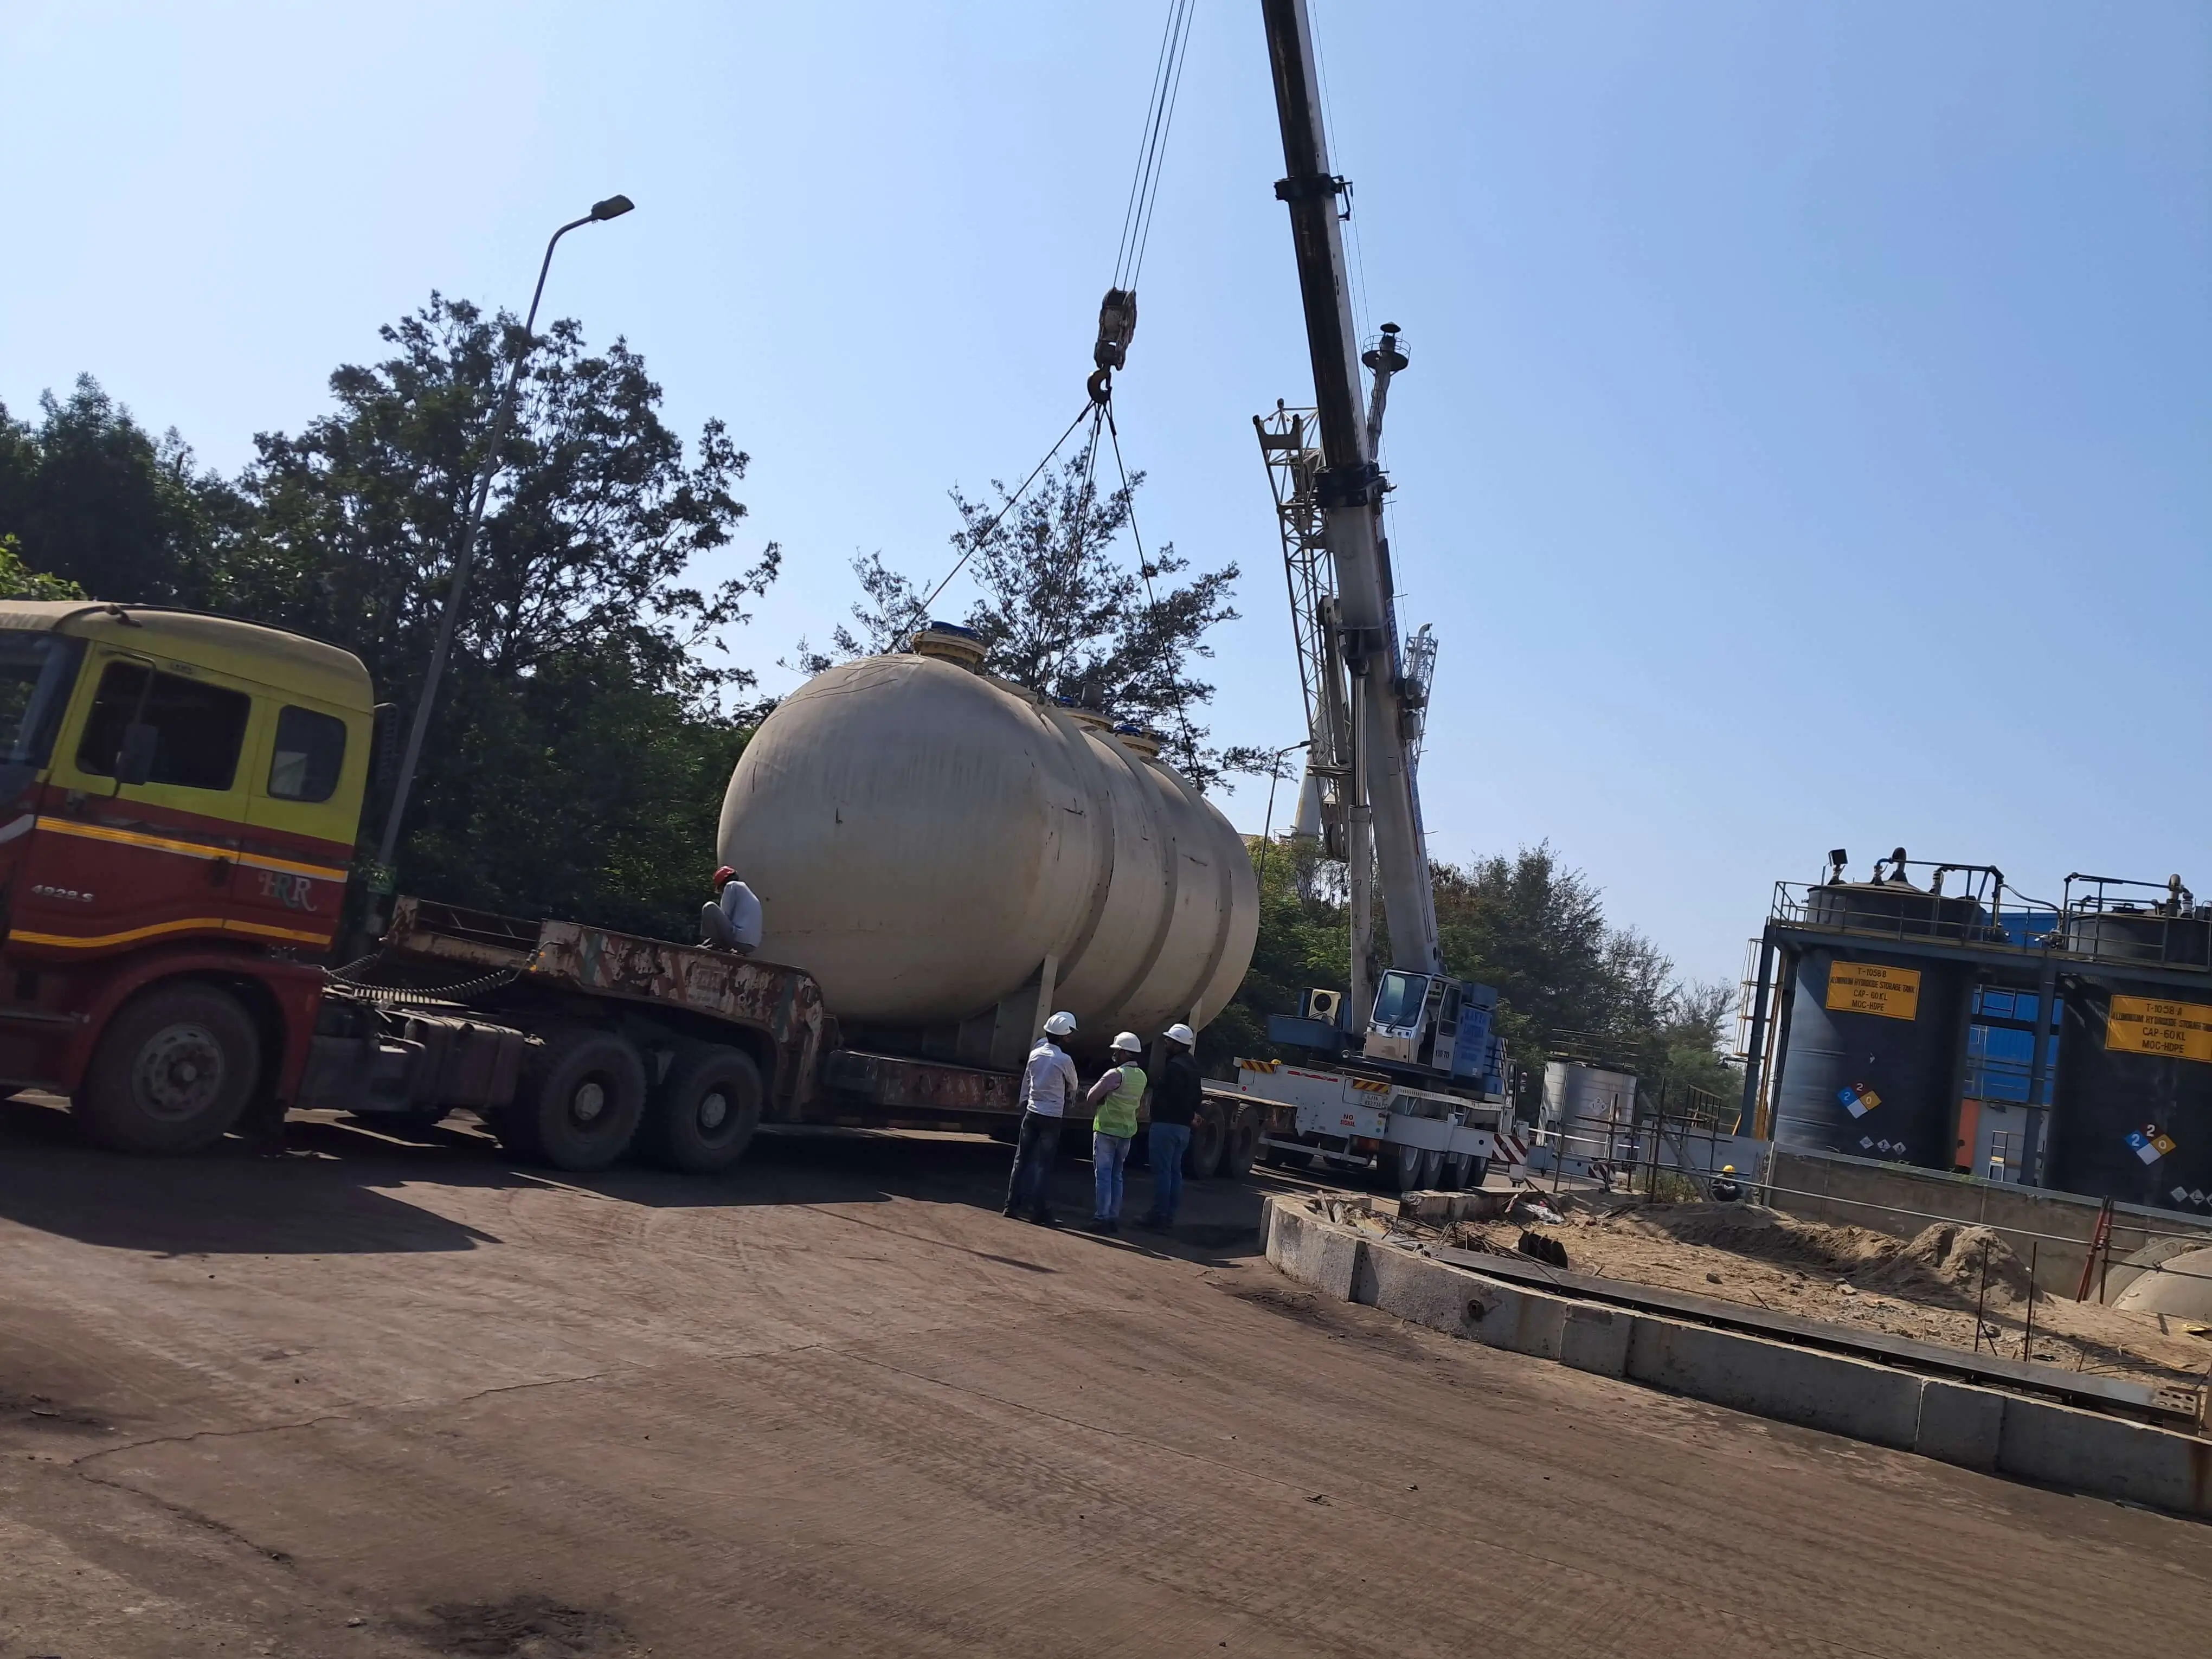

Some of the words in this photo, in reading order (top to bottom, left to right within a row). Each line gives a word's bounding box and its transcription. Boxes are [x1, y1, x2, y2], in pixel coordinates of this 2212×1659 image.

[1879, 982, 1901, 992] STORAGE
[1856, 1083, 1863, 1091] 2
[1844, 1092, 1850, 1101] 2
[1866, 1096, 1872, 1104] 0
[2146, 1124, 2156, 1137] 2
[2131, 1134, 2140, 1147] 2
[2158, 1140, 2167, 1149] 0
